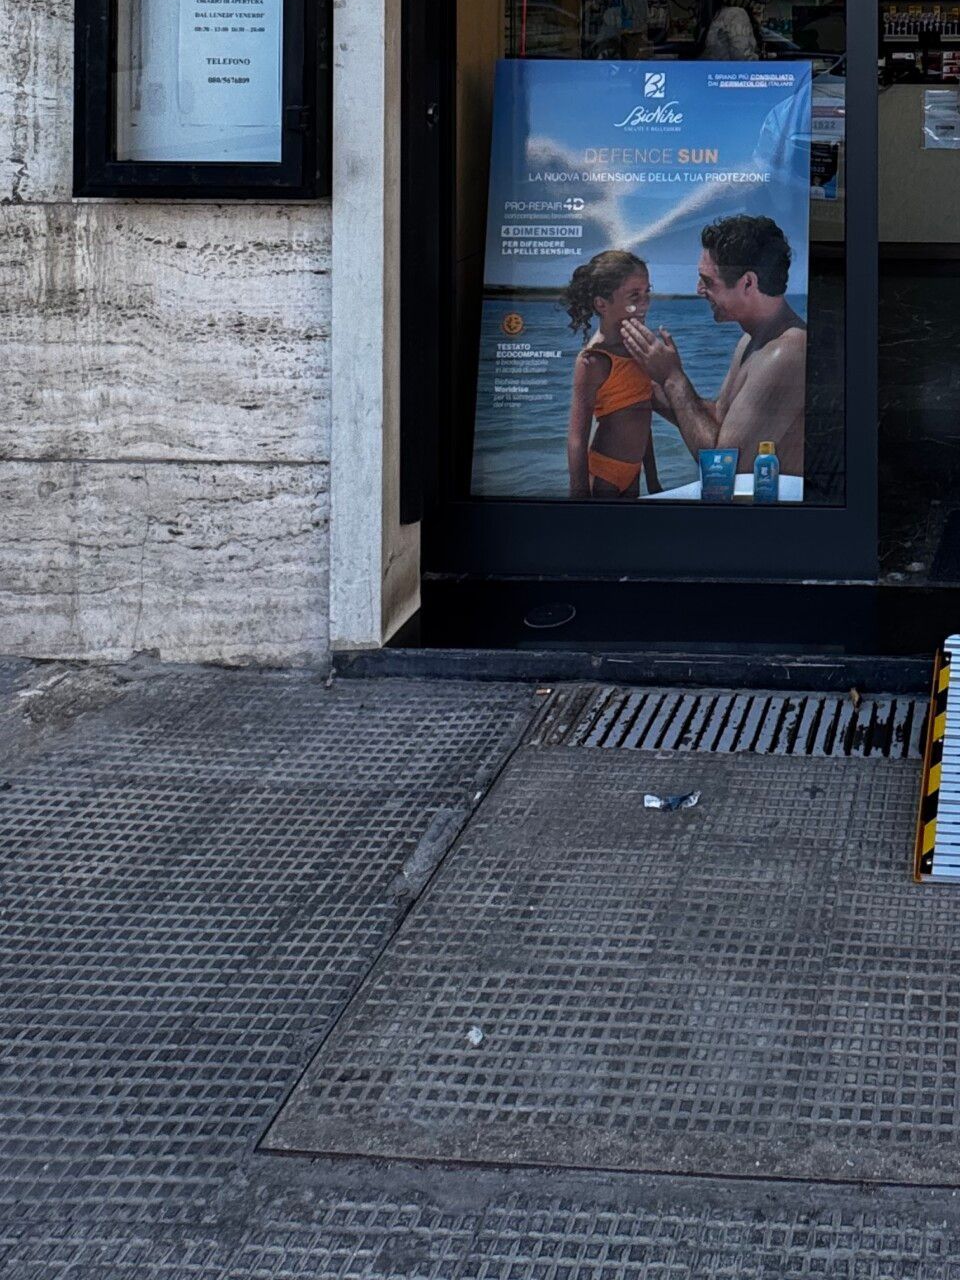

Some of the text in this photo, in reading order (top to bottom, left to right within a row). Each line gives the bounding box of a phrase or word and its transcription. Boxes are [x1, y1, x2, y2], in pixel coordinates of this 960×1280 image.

[206, 57, 251, 65] TELEFONO
[585, 148, 719, 164] DEFENCE SUN
[529, 172, 770, 182] LA NUOVA DIMENSIONE DELLA TUA PROTEZIONE
[503, 227, 580, 236] 4 DIMENSIONI
[497, 343, 531, 351] TESTATO
[496, 350, 562, 358] ECOCOMPATIBILE
